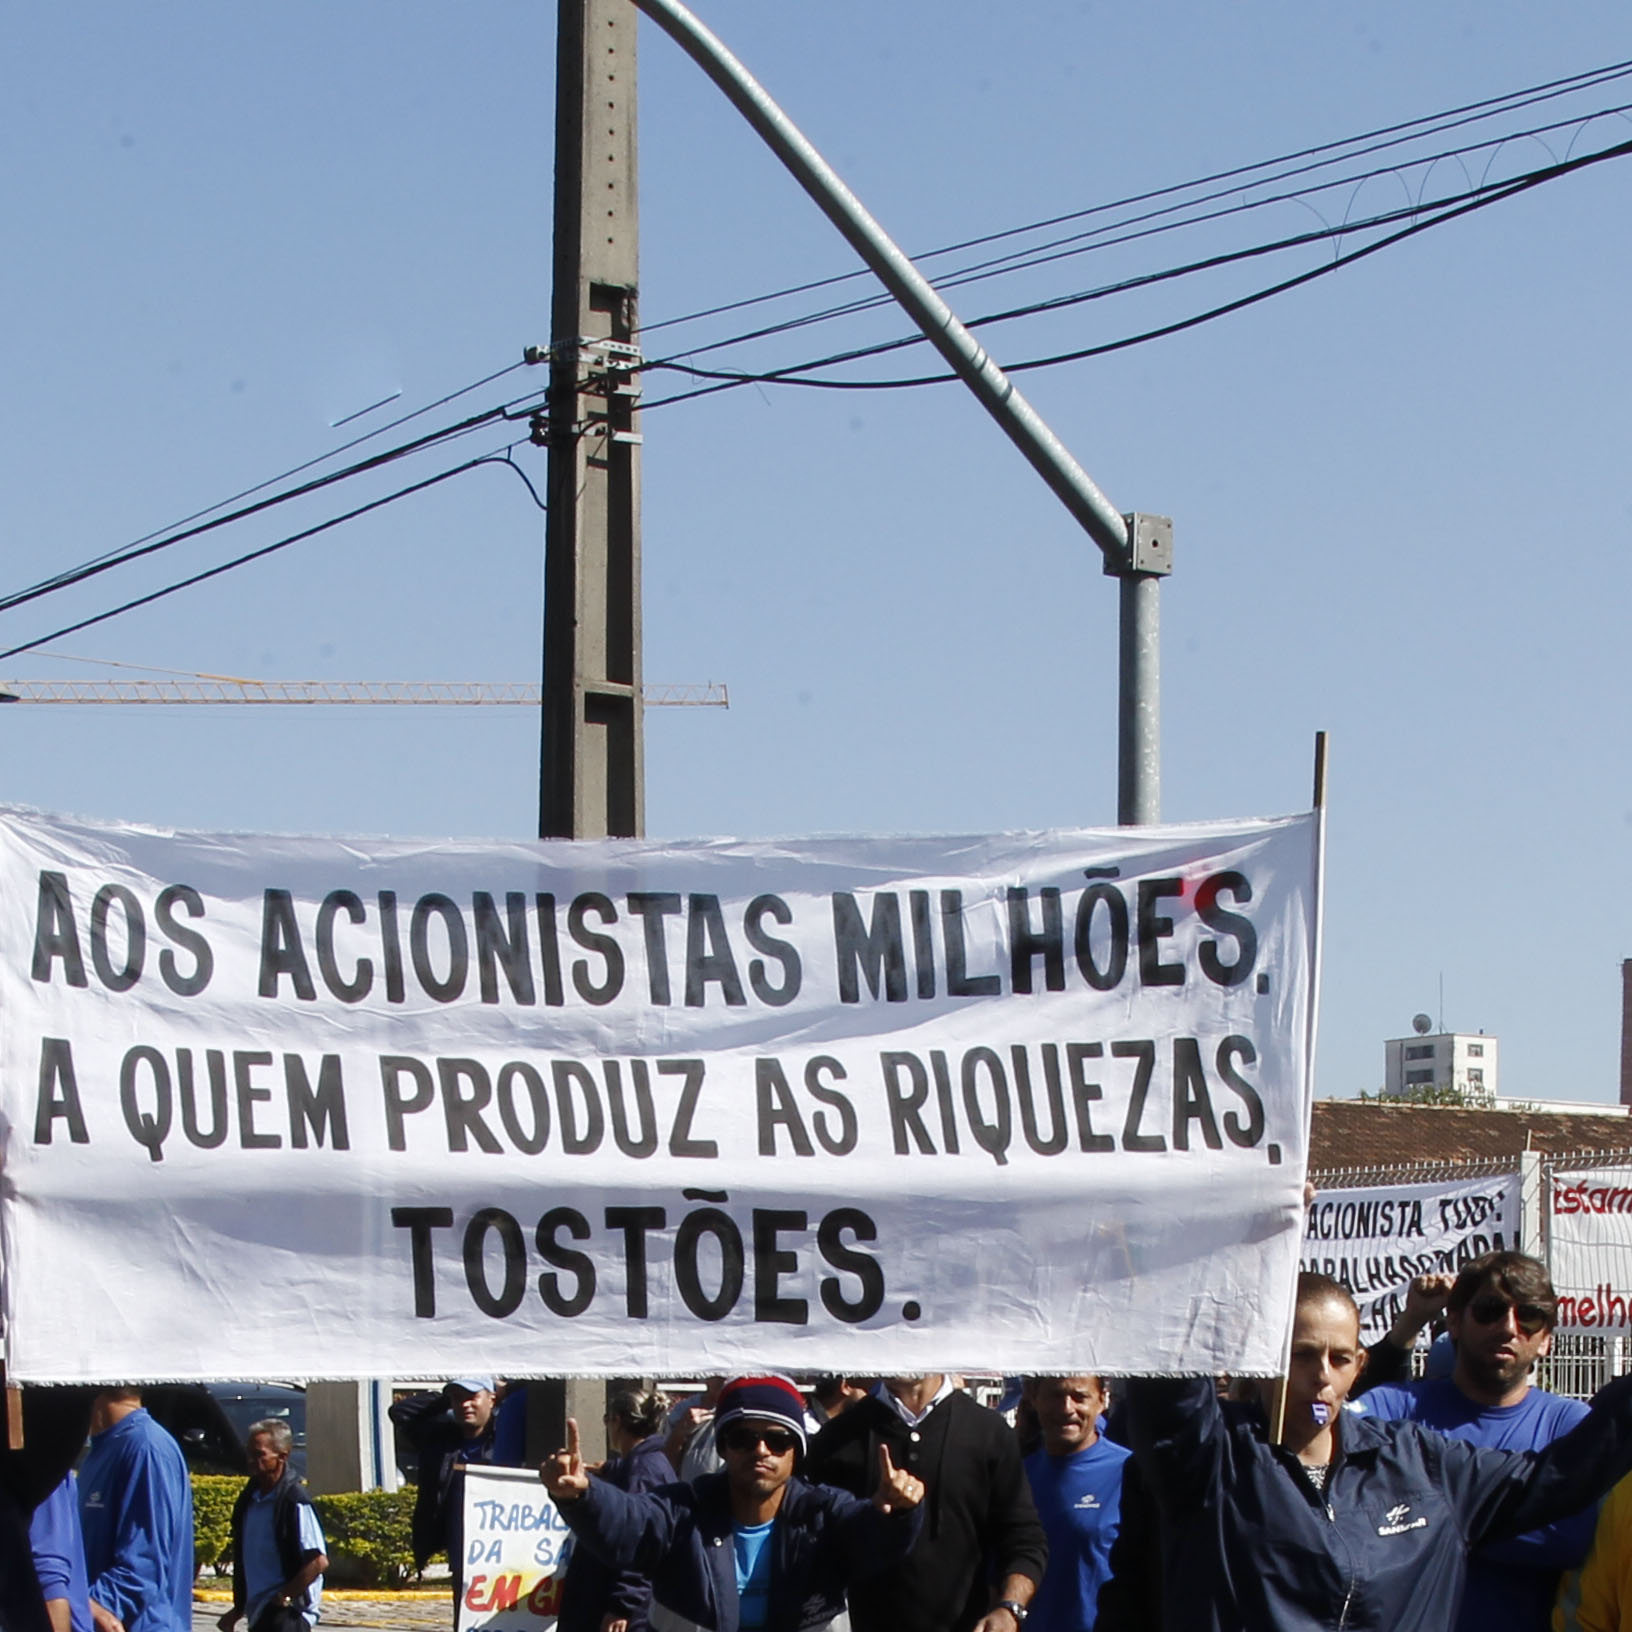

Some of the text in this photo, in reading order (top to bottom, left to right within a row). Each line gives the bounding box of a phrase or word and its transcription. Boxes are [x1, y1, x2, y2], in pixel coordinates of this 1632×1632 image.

[30, 866, 1271, 1008] AOS ACIONISTAS MILHÕES.
[32, 1034, 1283, 1167] A QUEM PRODUZ AS RIQUEZAS.
[389, 1187, 922, 1326] TOSTÕES.
[465, 1573, 523, 1613] EM
[467, 1538, 503, 1565] DA
